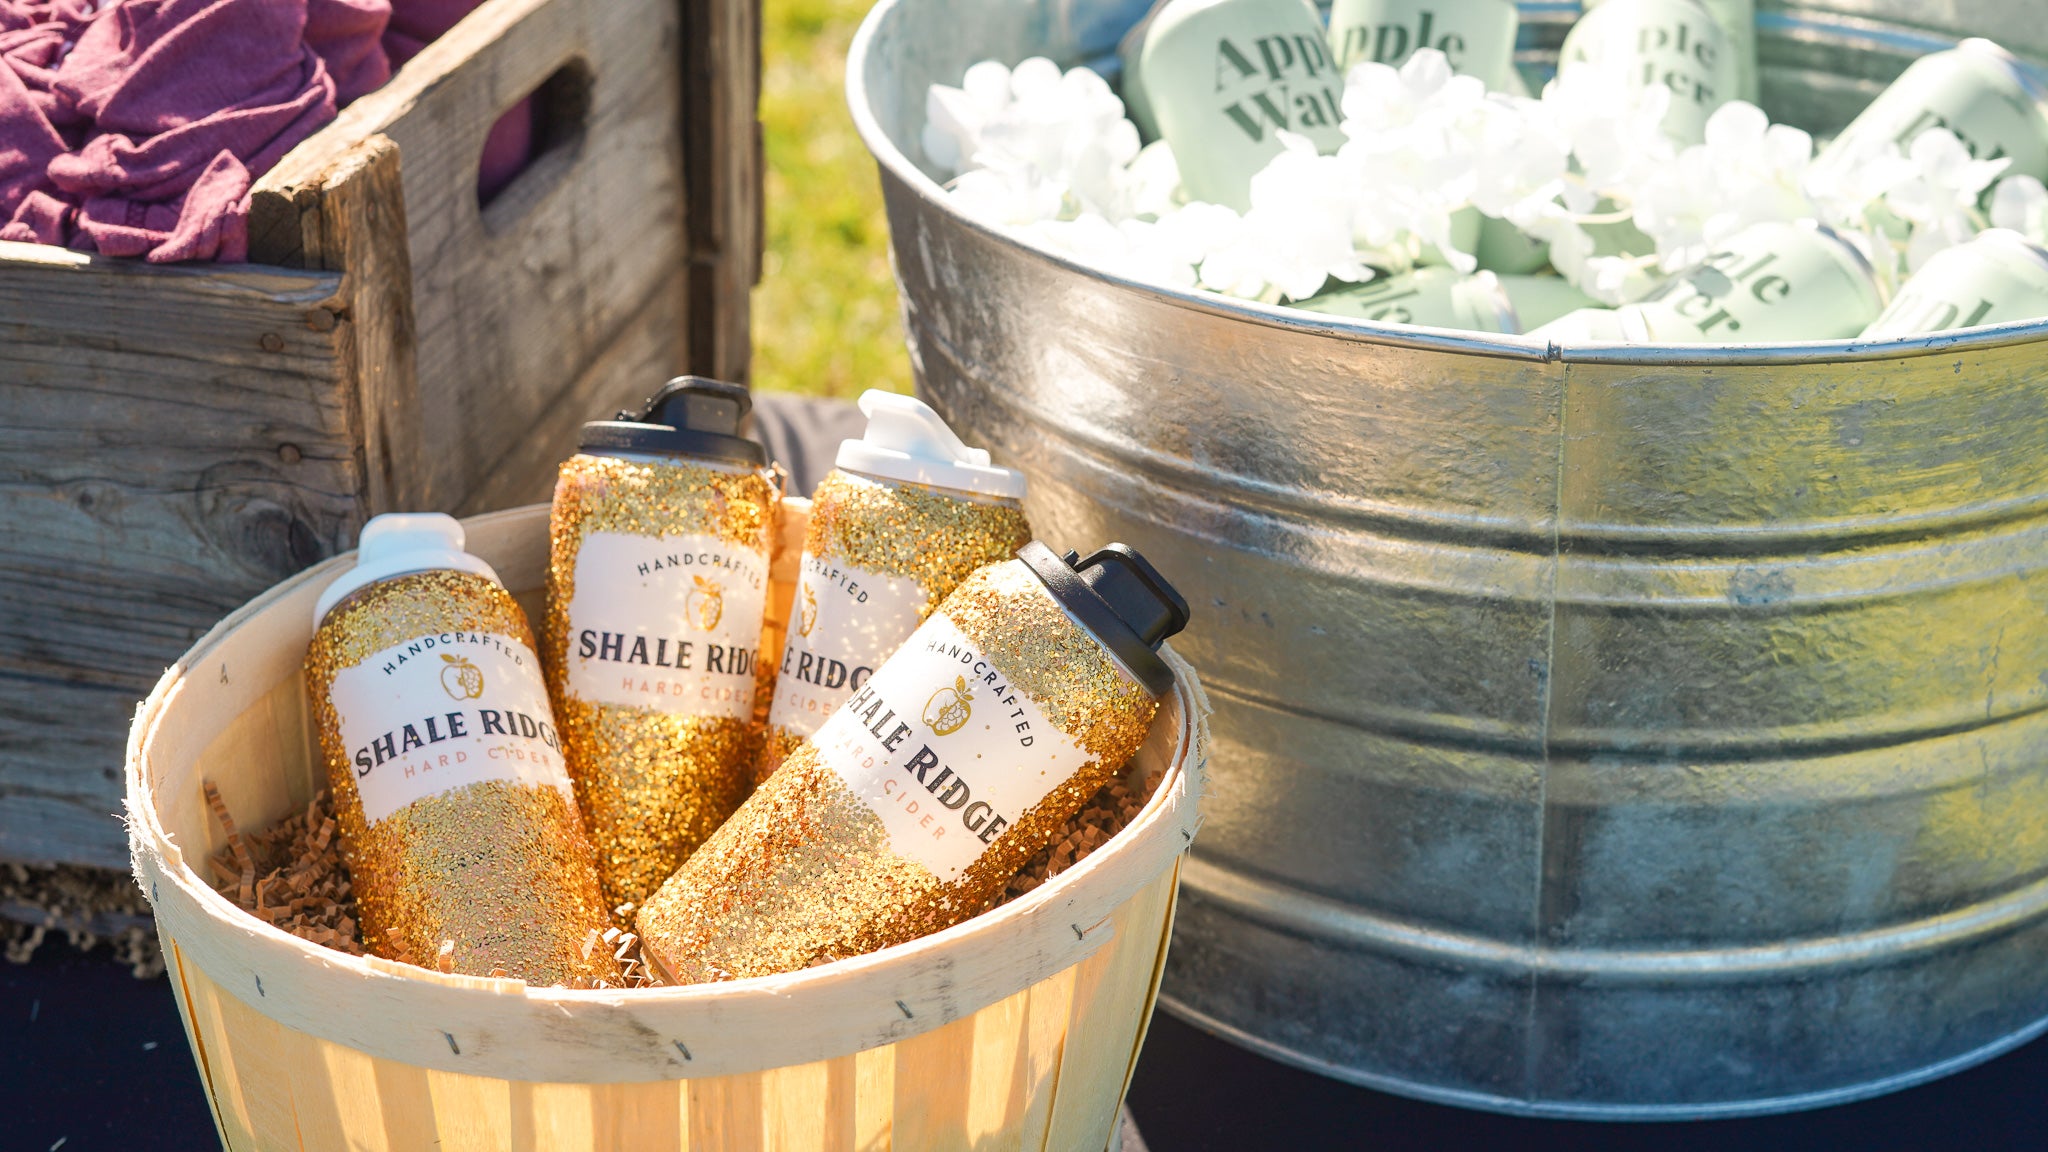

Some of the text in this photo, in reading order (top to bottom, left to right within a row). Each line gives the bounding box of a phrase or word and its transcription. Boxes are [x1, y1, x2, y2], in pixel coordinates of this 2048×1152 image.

[1215, 30, 1331, 93] App
[1341, 10, 1466, 74] pple
[1222, 83, 1345, 143] Wat
[806, 559, 869, 603] CRAFTED
[383, 632, 523, 676] HANDCRAFTED
[579, 629, 693, 670] SHALE
[706, 643, 758, 677] RIDG
[796, 650, 873, 692] RIDG
[622, 677, 684, 697] HARD
[790, 693, 832, 716] CIDE
[927, 641, 1034, 749] HANDCRAFTED
[355, 711, 468, 778] SHALE
[847, 684, 912, 753] HALE
[404, 751, 467, 778] HARD
[903, 743, 1008, 844] RIDGE
[884, 779, 946, 840] CIDER
